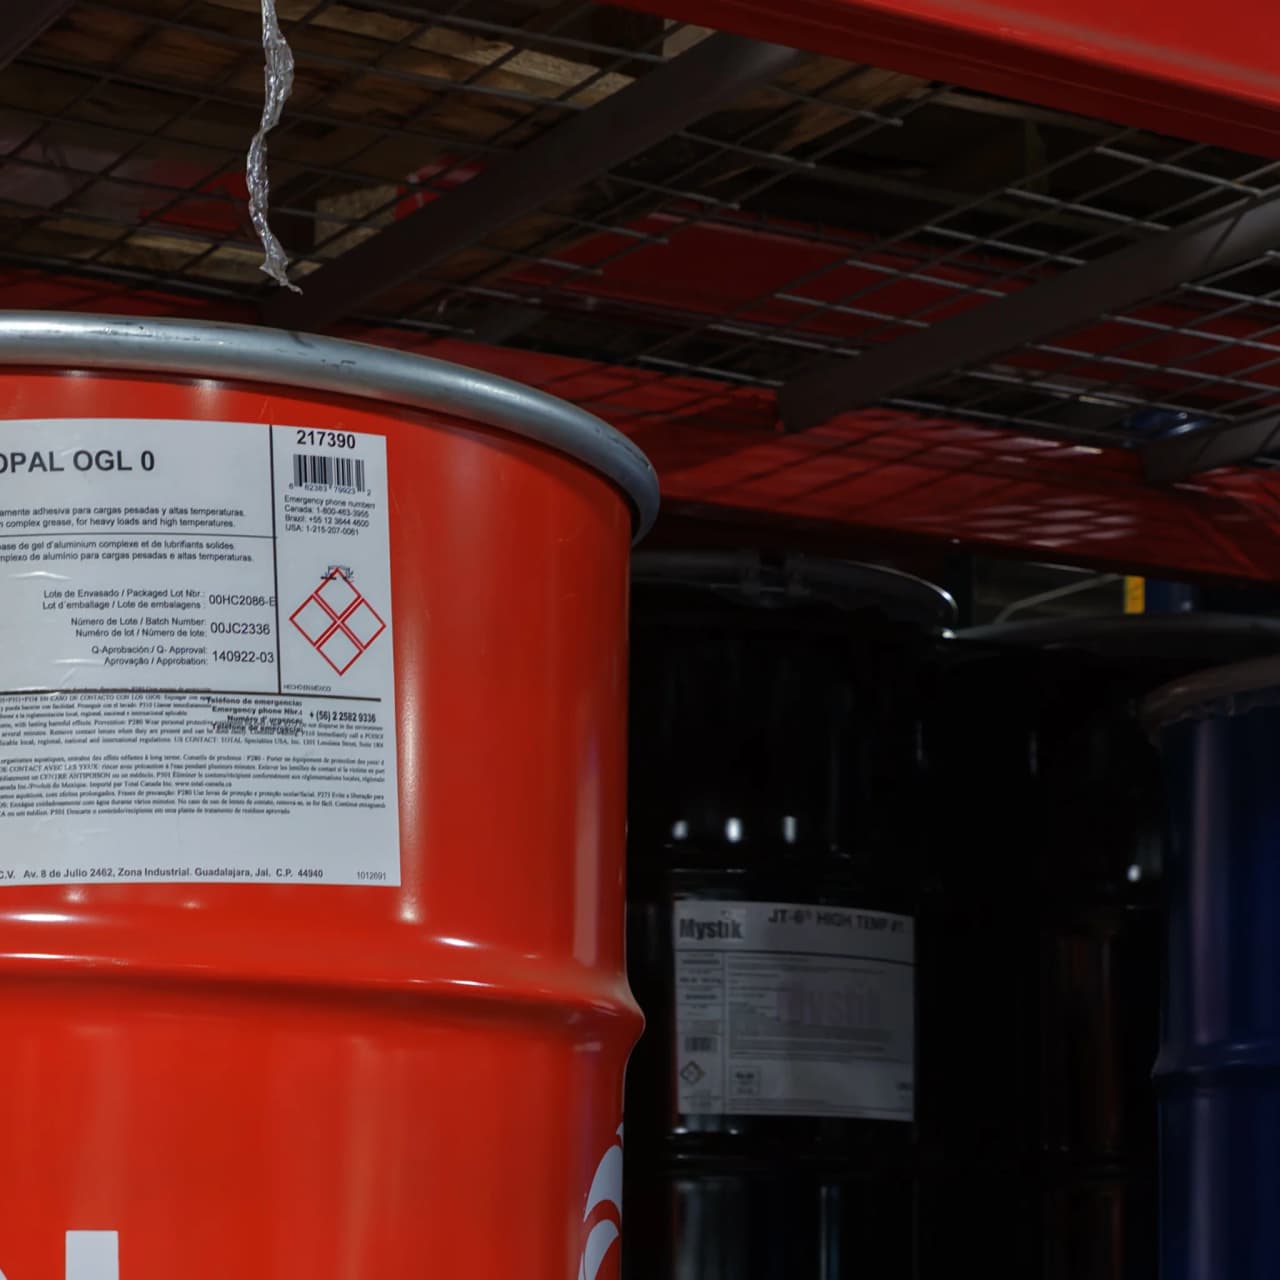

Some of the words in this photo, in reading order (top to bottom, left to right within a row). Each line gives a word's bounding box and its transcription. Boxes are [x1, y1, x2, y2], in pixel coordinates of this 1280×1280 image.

[296, 430, 356, 449] 217390
[73, 450, 133, 472] OGL
[33, 507, 70, 516] adhesiva
[72, 507, 91, 516] para
[94, 507, 122, 516] cargas
[124, 506, 159, 516] pesadas
[169, 506, 188, 516] altas
[6, 519, 40, 529] complex
[76, 517, 87, 526] for
[90, 517, 115, 527] heavy
[117, 517, 140, 526] loads
[142, 517, 157, 526] and
[160, 516, 178, 527] high
[18, 542, 29, 551] de
[31, 541, 44, 551] gel
[99, 540, 139, 550] complexe
[141, 540, 149, 548] et
[151, 540, 162, 549] de
[164, 539, 204, 549] lubrifiants
[44, 589, 62, 598] Lote
[64, 589, 75, 598] de
[78, 589, 119, 598] Envasado
[127, 588, 168, 600] Packaged
[170, 589, 183, 598] Lot
[43, 601, 56, 611] Lot
[117, 600, 136, 609] Lote
[138, 600, 149, 609] de
[151, 600, 201, 611] embalagens
[71, 617, 104, 626] Número
[107, 617, 117, 626] de
[120, 617, 138, 625] Lote
[146, 616, 169, 626] Batch
[172, 616, 206, 626] Number:
[76, 629, 109, 638] Numéro
[111, 628, 122, 637] de
[124, 628, 134, 637] lot
[142, 628, 175, 637] Número
[177, 628, 188, 637] de
[190, 629, 207, 638] lote:
[212, 651, 274, 663] 140922-03
[212, 705, 256, 715] Emergency
[258, 706, 282, 716] phone
[24, 869, 38, 879] Av.
[49, 869, 61, 878] de
[64, 868, 87, 878] Julio
[118, 867, 142, 877] Zona
[680, 917, 744, 940] Mystik
